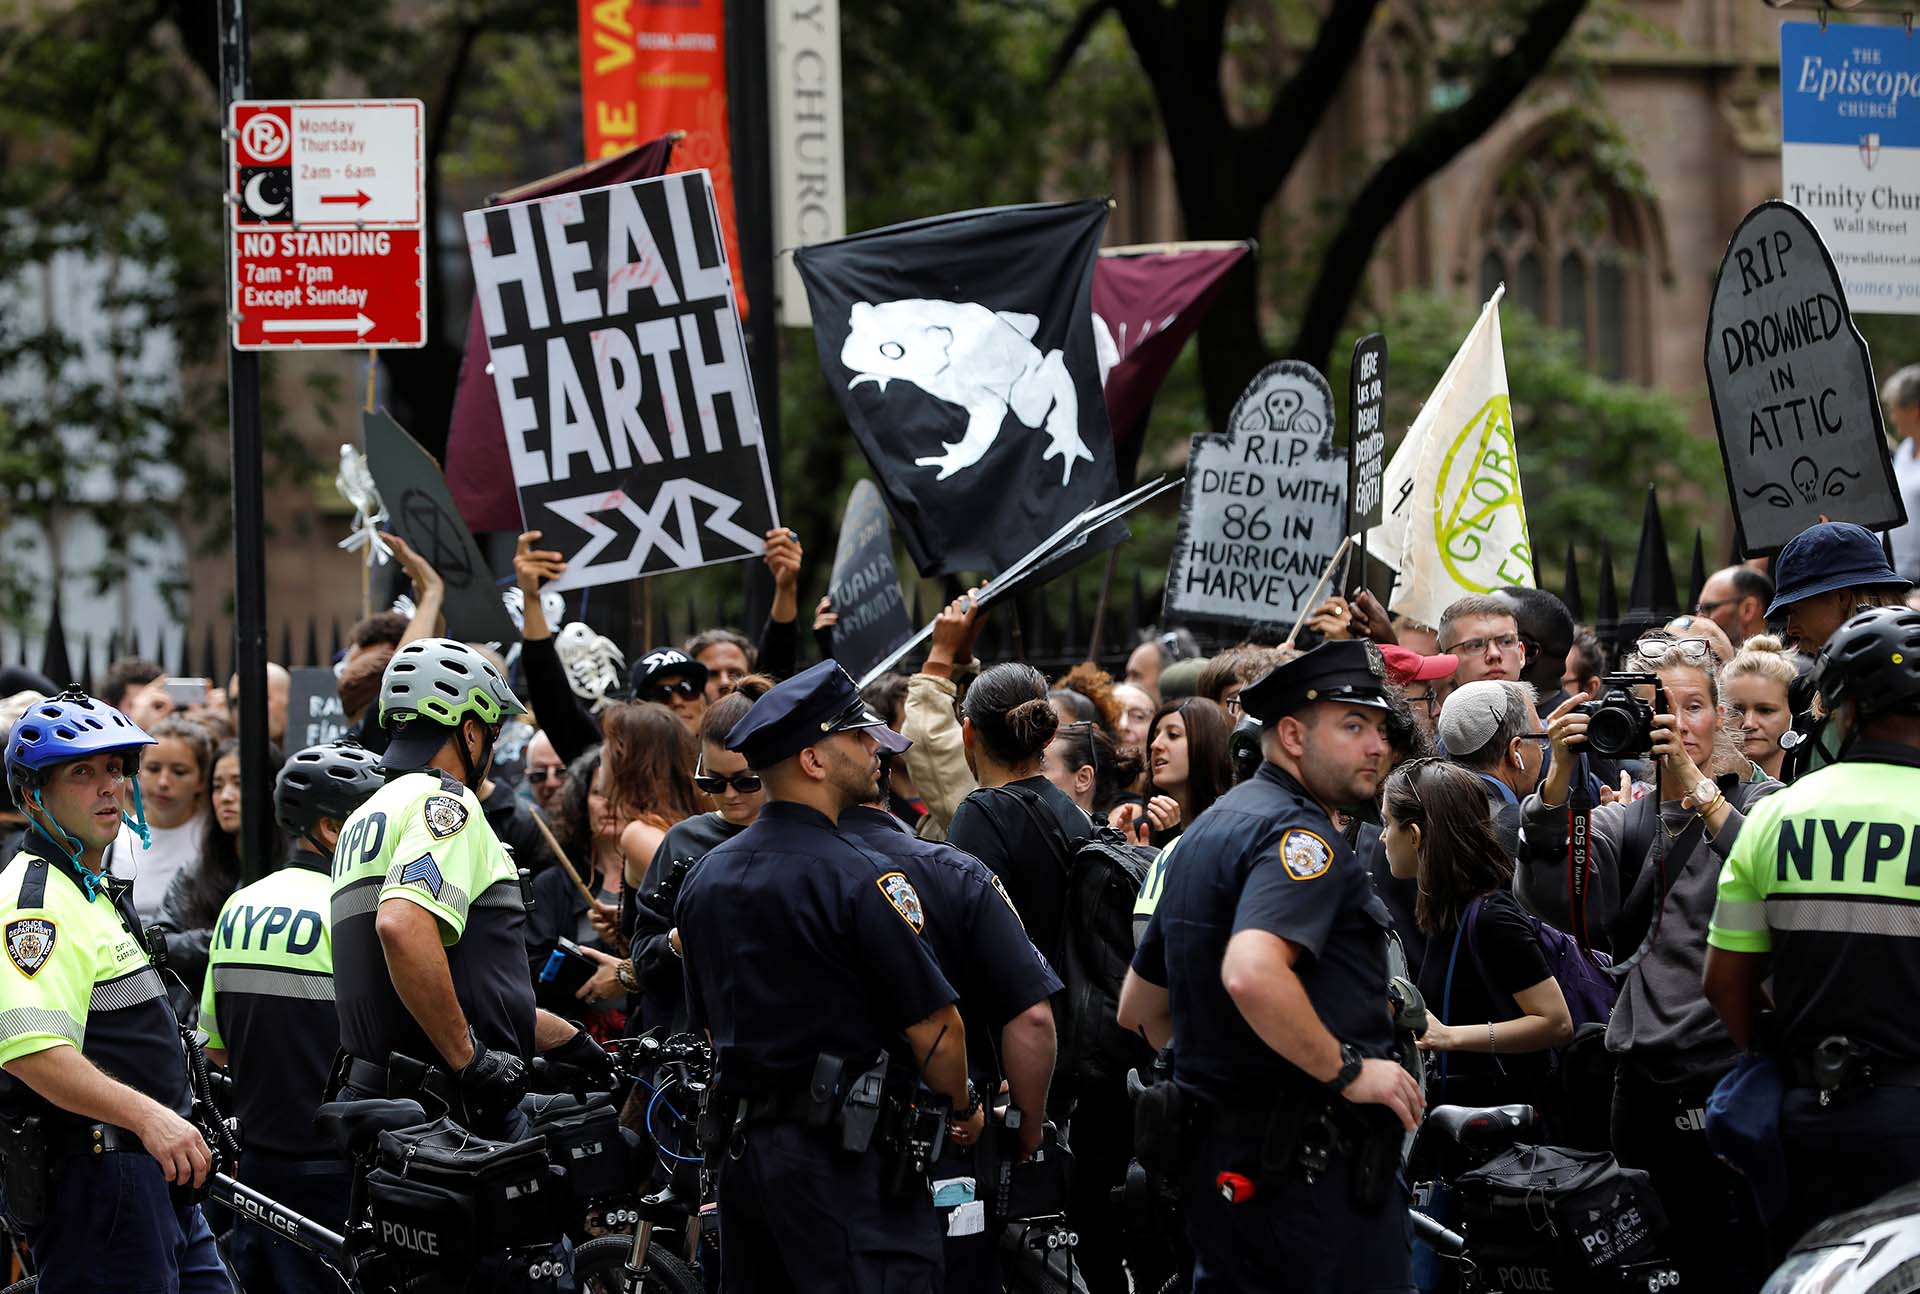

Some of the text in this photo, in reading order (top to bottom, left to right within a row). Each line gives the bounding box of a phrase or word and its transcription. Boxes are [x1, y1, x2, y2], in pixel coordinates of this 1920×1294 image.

[1852, 48, 1881, 65] THE
[1838, 101, 1897, 119] CHURCH
[300, 119, 355, 136] Monday
[300, 138, 366, 154] Thursday
[300, 164, 331, 180] 2am
[345, 165, 376, 179] 6am
[1790, 183, 1867, 213] Trinity
[1833, 217, 1907, 234] Wall Street
[243, 232, 391, 258] NO STANDING
[463, 174, 729, 338] HEAL
[245, 264, 281, 283] 7am
[296, 263, 333, 284] 7pm
[1734, 231, 1792, 296] RIP
[245, 285, 368, 310] Except Sunday
[1722, 294, 1842, 375] DROWNED
[1360, 351, 1379, 382] HERE
[1770, 362, 1795, 394] IN
[490, 307, 760, 487] EARTH
[1370, 379, 1382, 399] OUR
[1749, 388, 1842, 456] ATTIC
[1244, 435, 1308, 468] R.I.P.
[1201, 469, 1340, 507] DIED WITH
[1355, 476, 1381, 516] EARTH
[1222, 503, 1313, 541] 86 IN
[1190, 541, 1333, 578] HURRICANE
[1186, 567, 1310, 612] HARVEY
[1575, 815, 1585, 845] EOS
[1575, 849, 1585, 864] 5D
[8, 926, 53, 938] DEPARTMENT
[18, 920, 43, 928] POLICE
[215, 905, 322, 955] NYPD
[233, 1192, 298, 1234] POLICE
[381, 1220, 440, 1256] POLICE
[1497, 1265, 1553, 1291] POLICE
